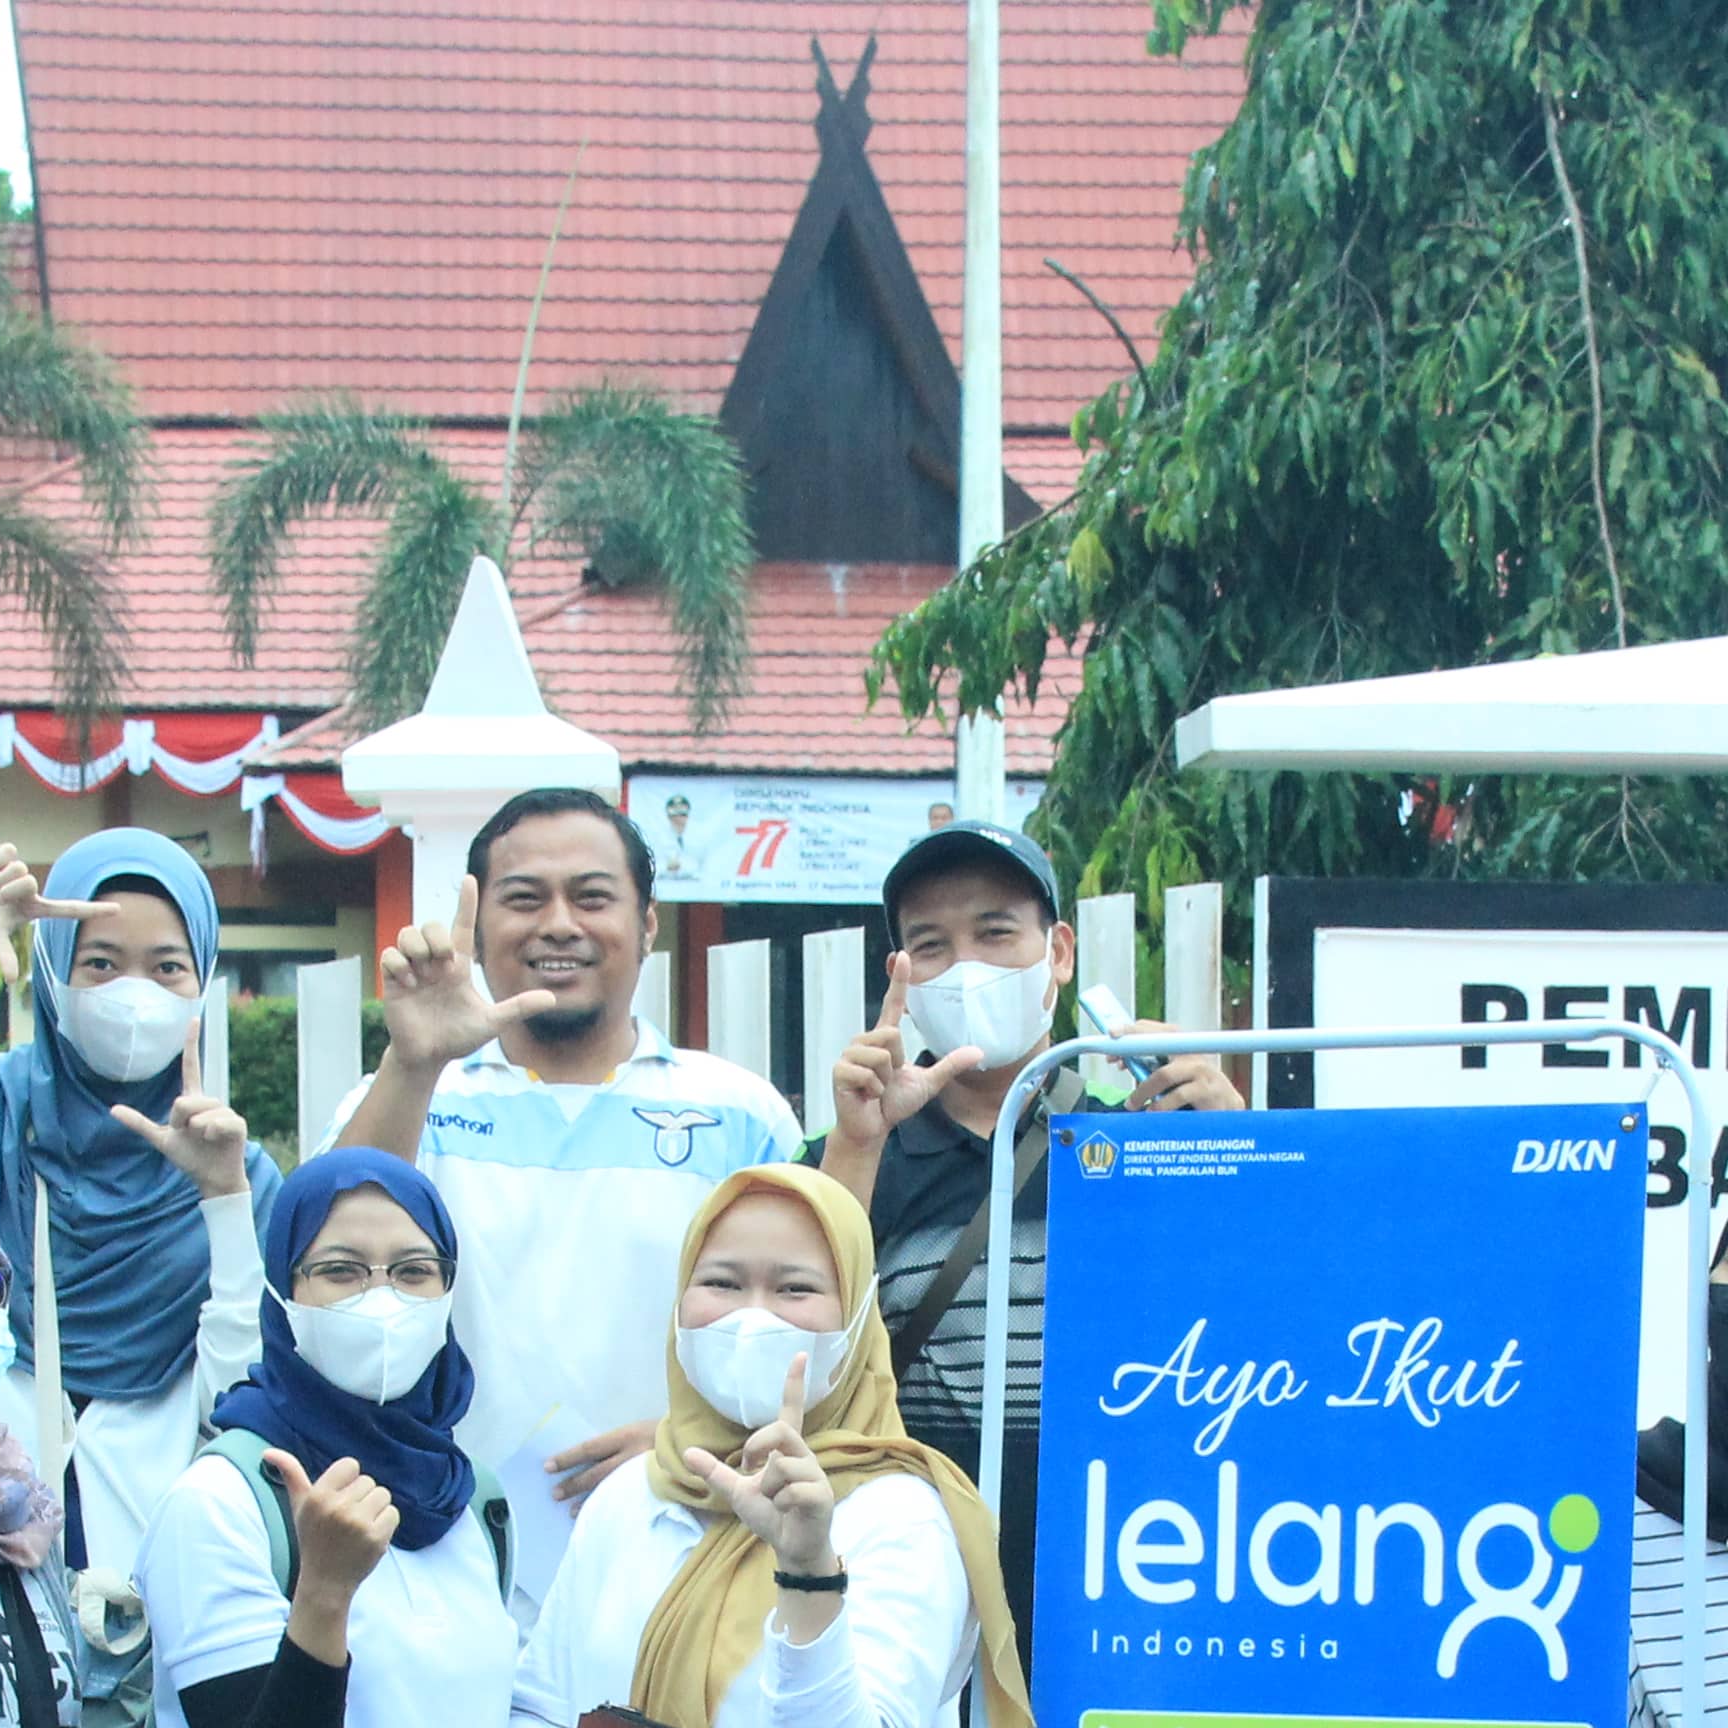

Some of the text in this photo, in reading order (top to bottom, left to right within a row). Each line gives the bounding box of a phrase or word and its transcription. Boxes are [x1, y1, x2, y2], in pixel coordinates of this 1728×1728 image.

[735, 818, 791, 876] 77
[1124, 1138, 1255, 1152] KEMENTERIAN KEUANGAN
[1124, 1154, 1177, 1164] DIREKTORAT
[1269, 1151, 1305, 1162] NEGARA
[1511, 1138, 1616, 1174] DJKN
[1156, 1166, 1215, 1177] PANGKALAN
[1217, 1165, 1238, 1176] BUN
[1098, 1316, 1523, 1456] Ayo Ikut
[1091, 1627, 1340, 1661] Indonesia
